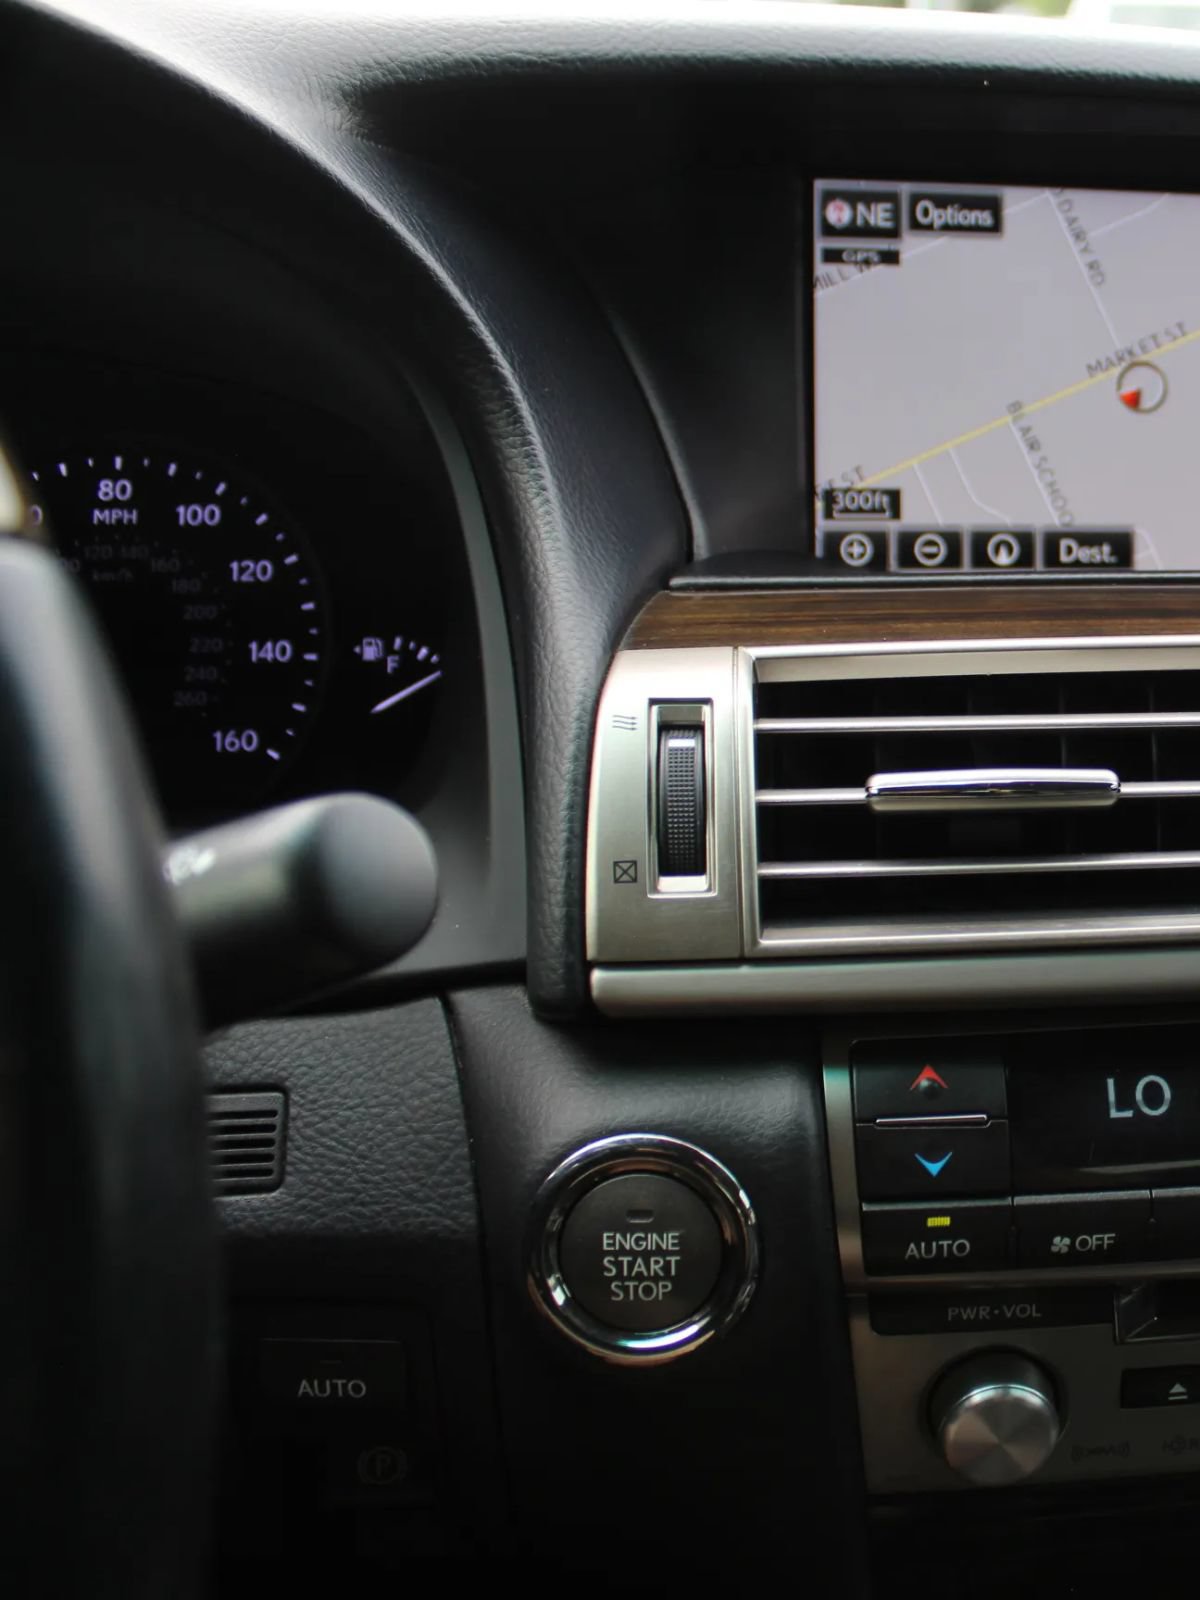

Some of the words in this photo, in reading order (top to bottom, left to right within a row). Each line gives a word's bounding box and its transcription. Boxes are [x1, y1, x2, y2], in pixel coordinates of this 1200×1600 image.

[856, 202, 895, 227] NE
[915, 200, 994, 229] Options
[1057, 198, 1095, 254] DAIRY
[1086, 258, 1106, 286] RD
[842, 250, 881, 264] GPS
[1086, 332, 1160, 378] MARKET
[1163, 320, 1188, 341] ST
[97, 478, 133, 502] 80
[834, 490, 892, 511] 300ft
[92, 509, 139, 525] MPH
[175, 503, 221, 527] 100
[1059, 537, 1117, 564] Dest.
[229, 559, 274, 583] 120
[248, 639, 292, 663] 140
[386, 655, 400, 674] F
[212, 728, 260, 753] 160
[1106, 1074, 1171, 1119] LO
[602, 1232, 680, 1251] ENGINE
[904, 1238, 970, 1260] AUTO
[1075, 1232, 1116, 1253] OFF
[602, 1256, 681, 1277] START
[610, 1281, 672, 1301] STOP
[297, 1379, 367, 1398] AUTO
